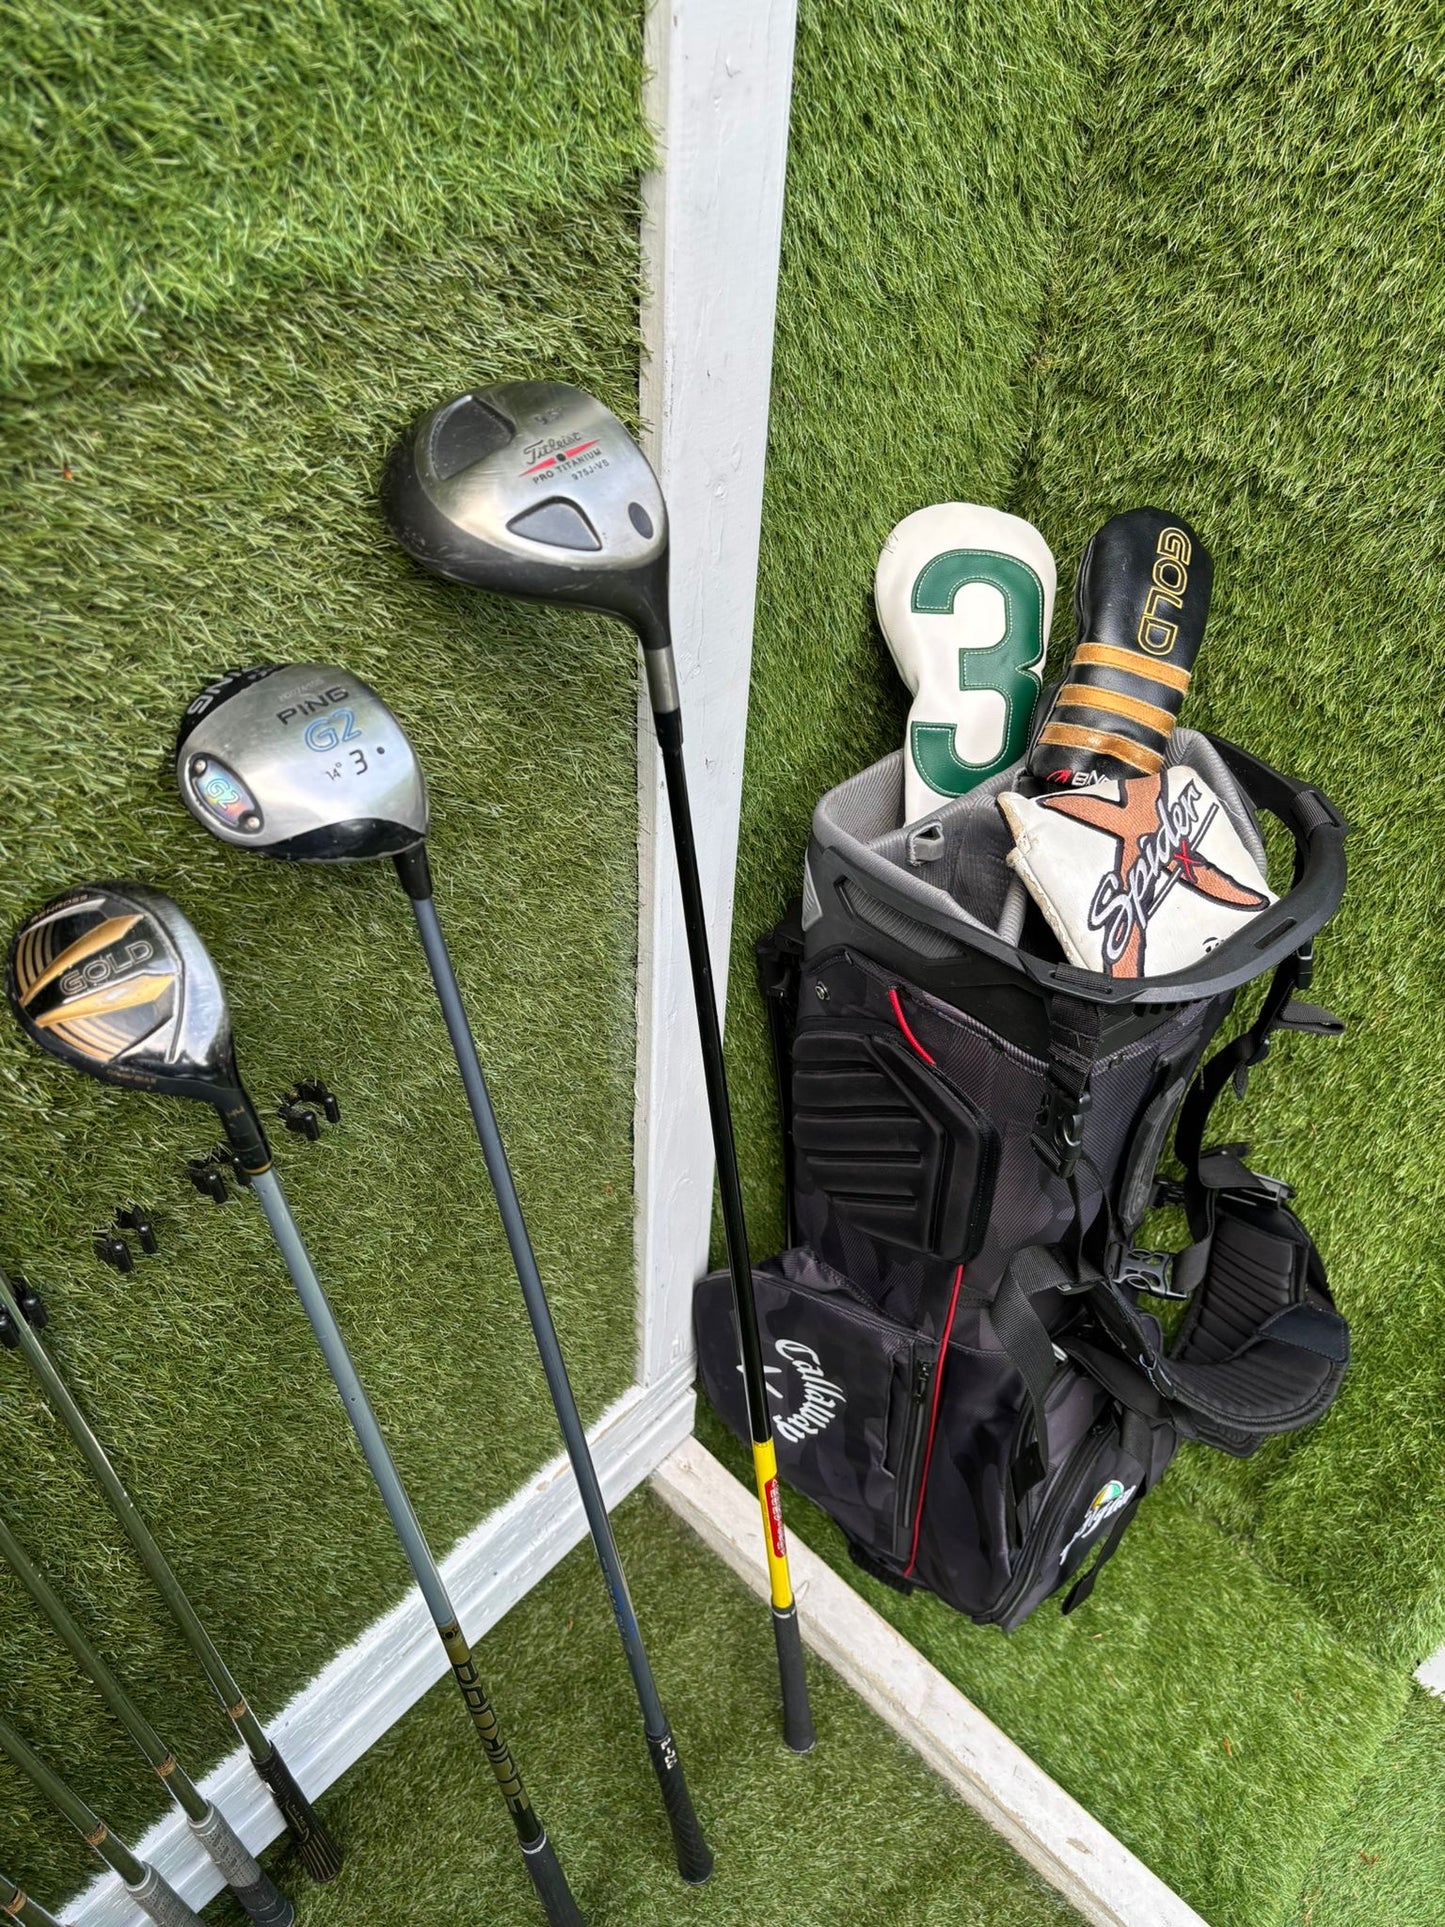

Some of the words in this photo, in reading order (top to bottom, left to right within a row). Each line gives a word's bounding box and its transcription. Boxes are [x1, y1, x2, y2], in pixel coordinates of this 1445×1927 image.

[523, 431, 583, 465] Titleist
[532, 469, 555, 485] PRO
[555, 448, 603, 474] TITANIUM
[1137, 526, 1192, 656] GOLD
[910, 547, 1044, 799] 3
[276, 685, 349, 726] PING
[305, 707, 362, 752] G2
[349, 749, 368, 775] 3
[206, 778, 240, 811] G2
[1088, 780, 1202, 965] Spider
[60, 940, 153, 996] GOLD
[772, 1338, 847, 1444] Callaway
